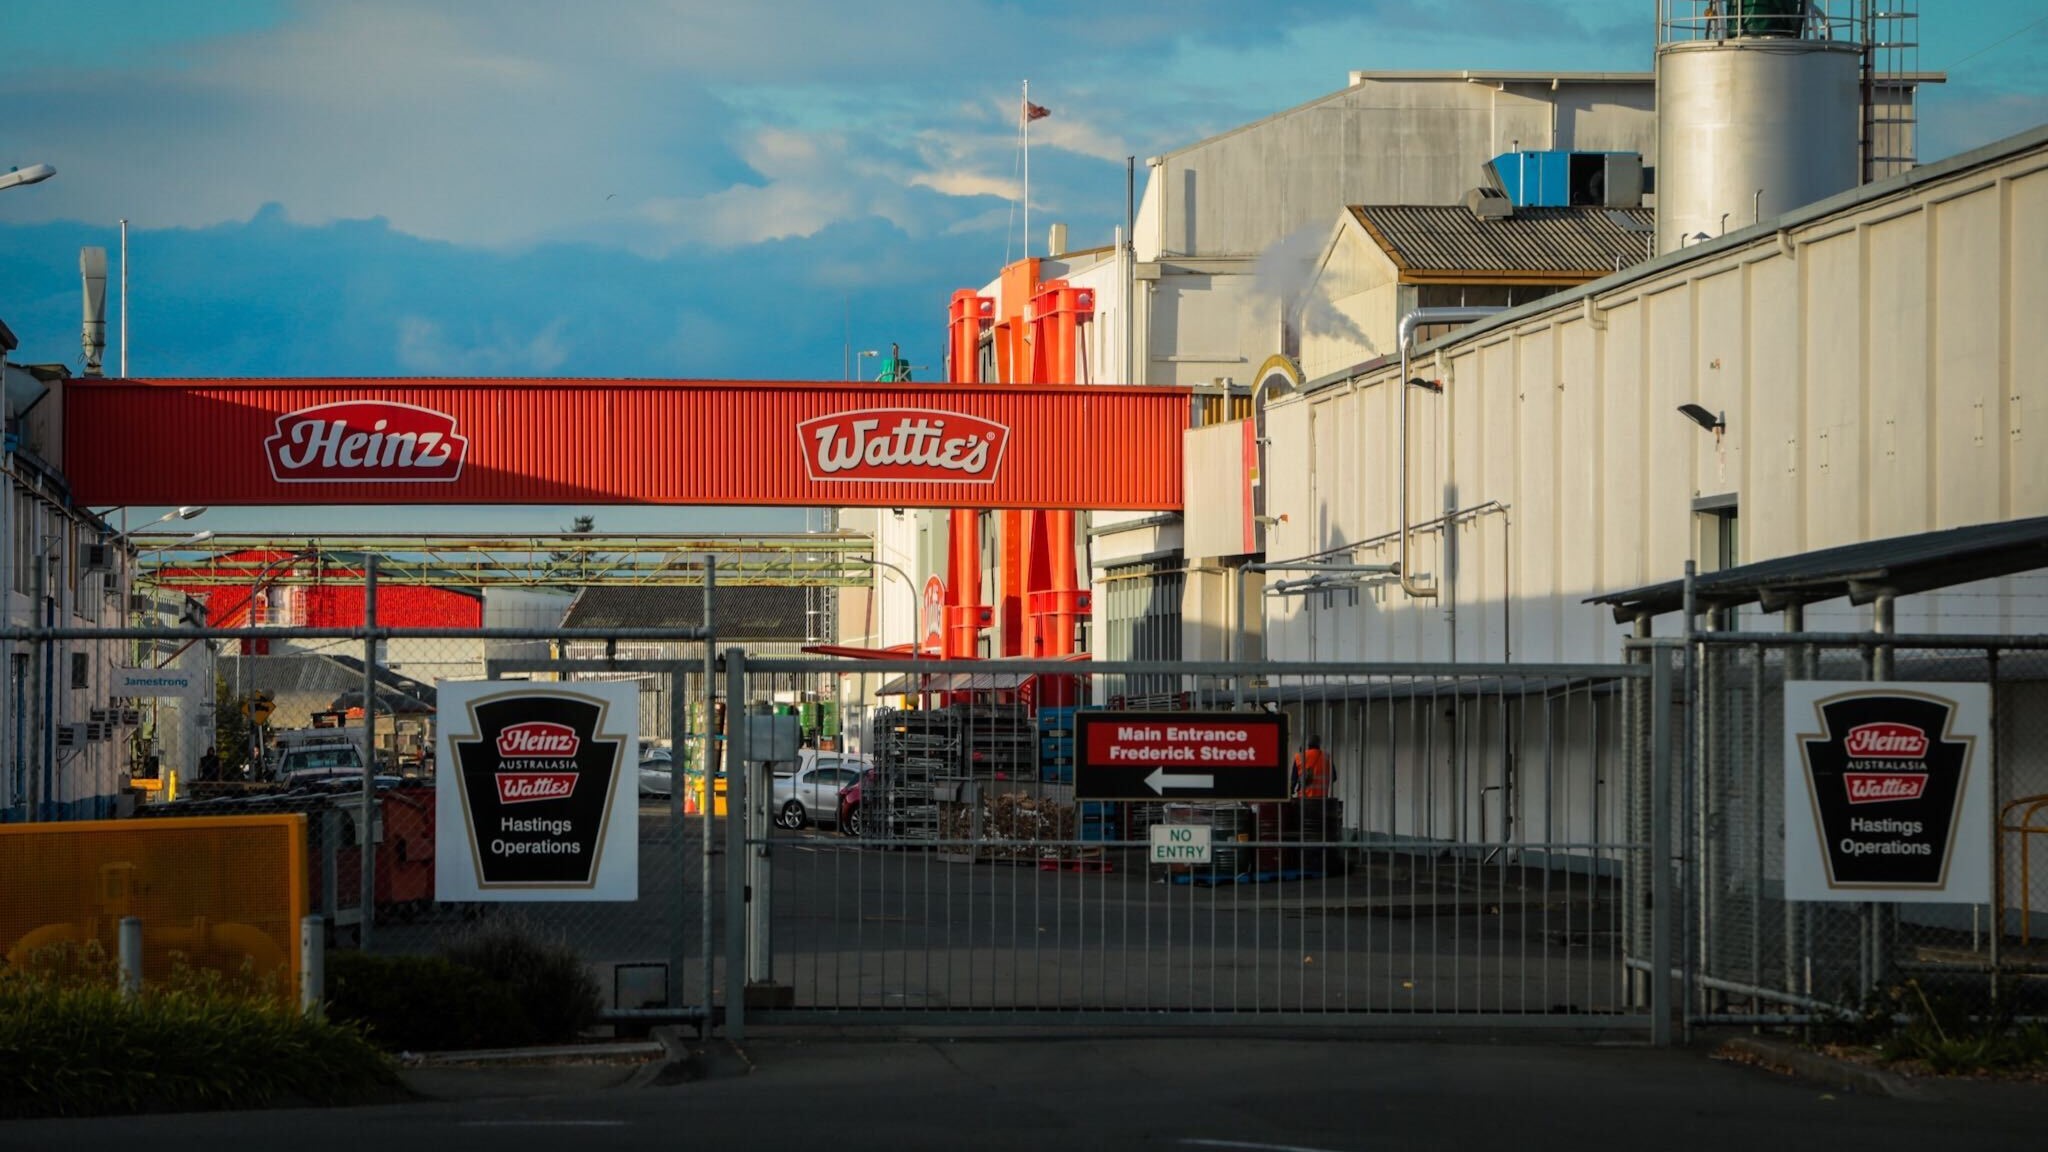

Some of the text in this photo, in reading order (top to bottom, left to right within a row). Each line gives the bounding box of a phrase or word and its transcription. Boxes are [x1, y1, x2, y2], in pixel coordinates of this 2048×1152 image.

[279, 419, 452, 469] Heinz
[815, 418, 990, 474] Wattie's
[124, 677, 188, 688] Jamestrong
[502, 729, 573, 752] Heinz
[1118, 727, 1248, 742] Main Entrance
[1850, 729, 1922, 752] Heinz
[1110, 746, 1256, 761] Frederick Street
[498, 760, 578, 769] AUSTRALASIA
[1847, 760, 1928, 770] AUSTRALASIA
[501, 817, 572, 836] Hastings
[1170, 829, 1192, 842] NO
[1850, 817, 1923, 837] Hastings
[491, 839, 581, 858] Operations
[1157, 845, 1205, 858] ENTRY
[1840, 838, 1932, 857] Operations
